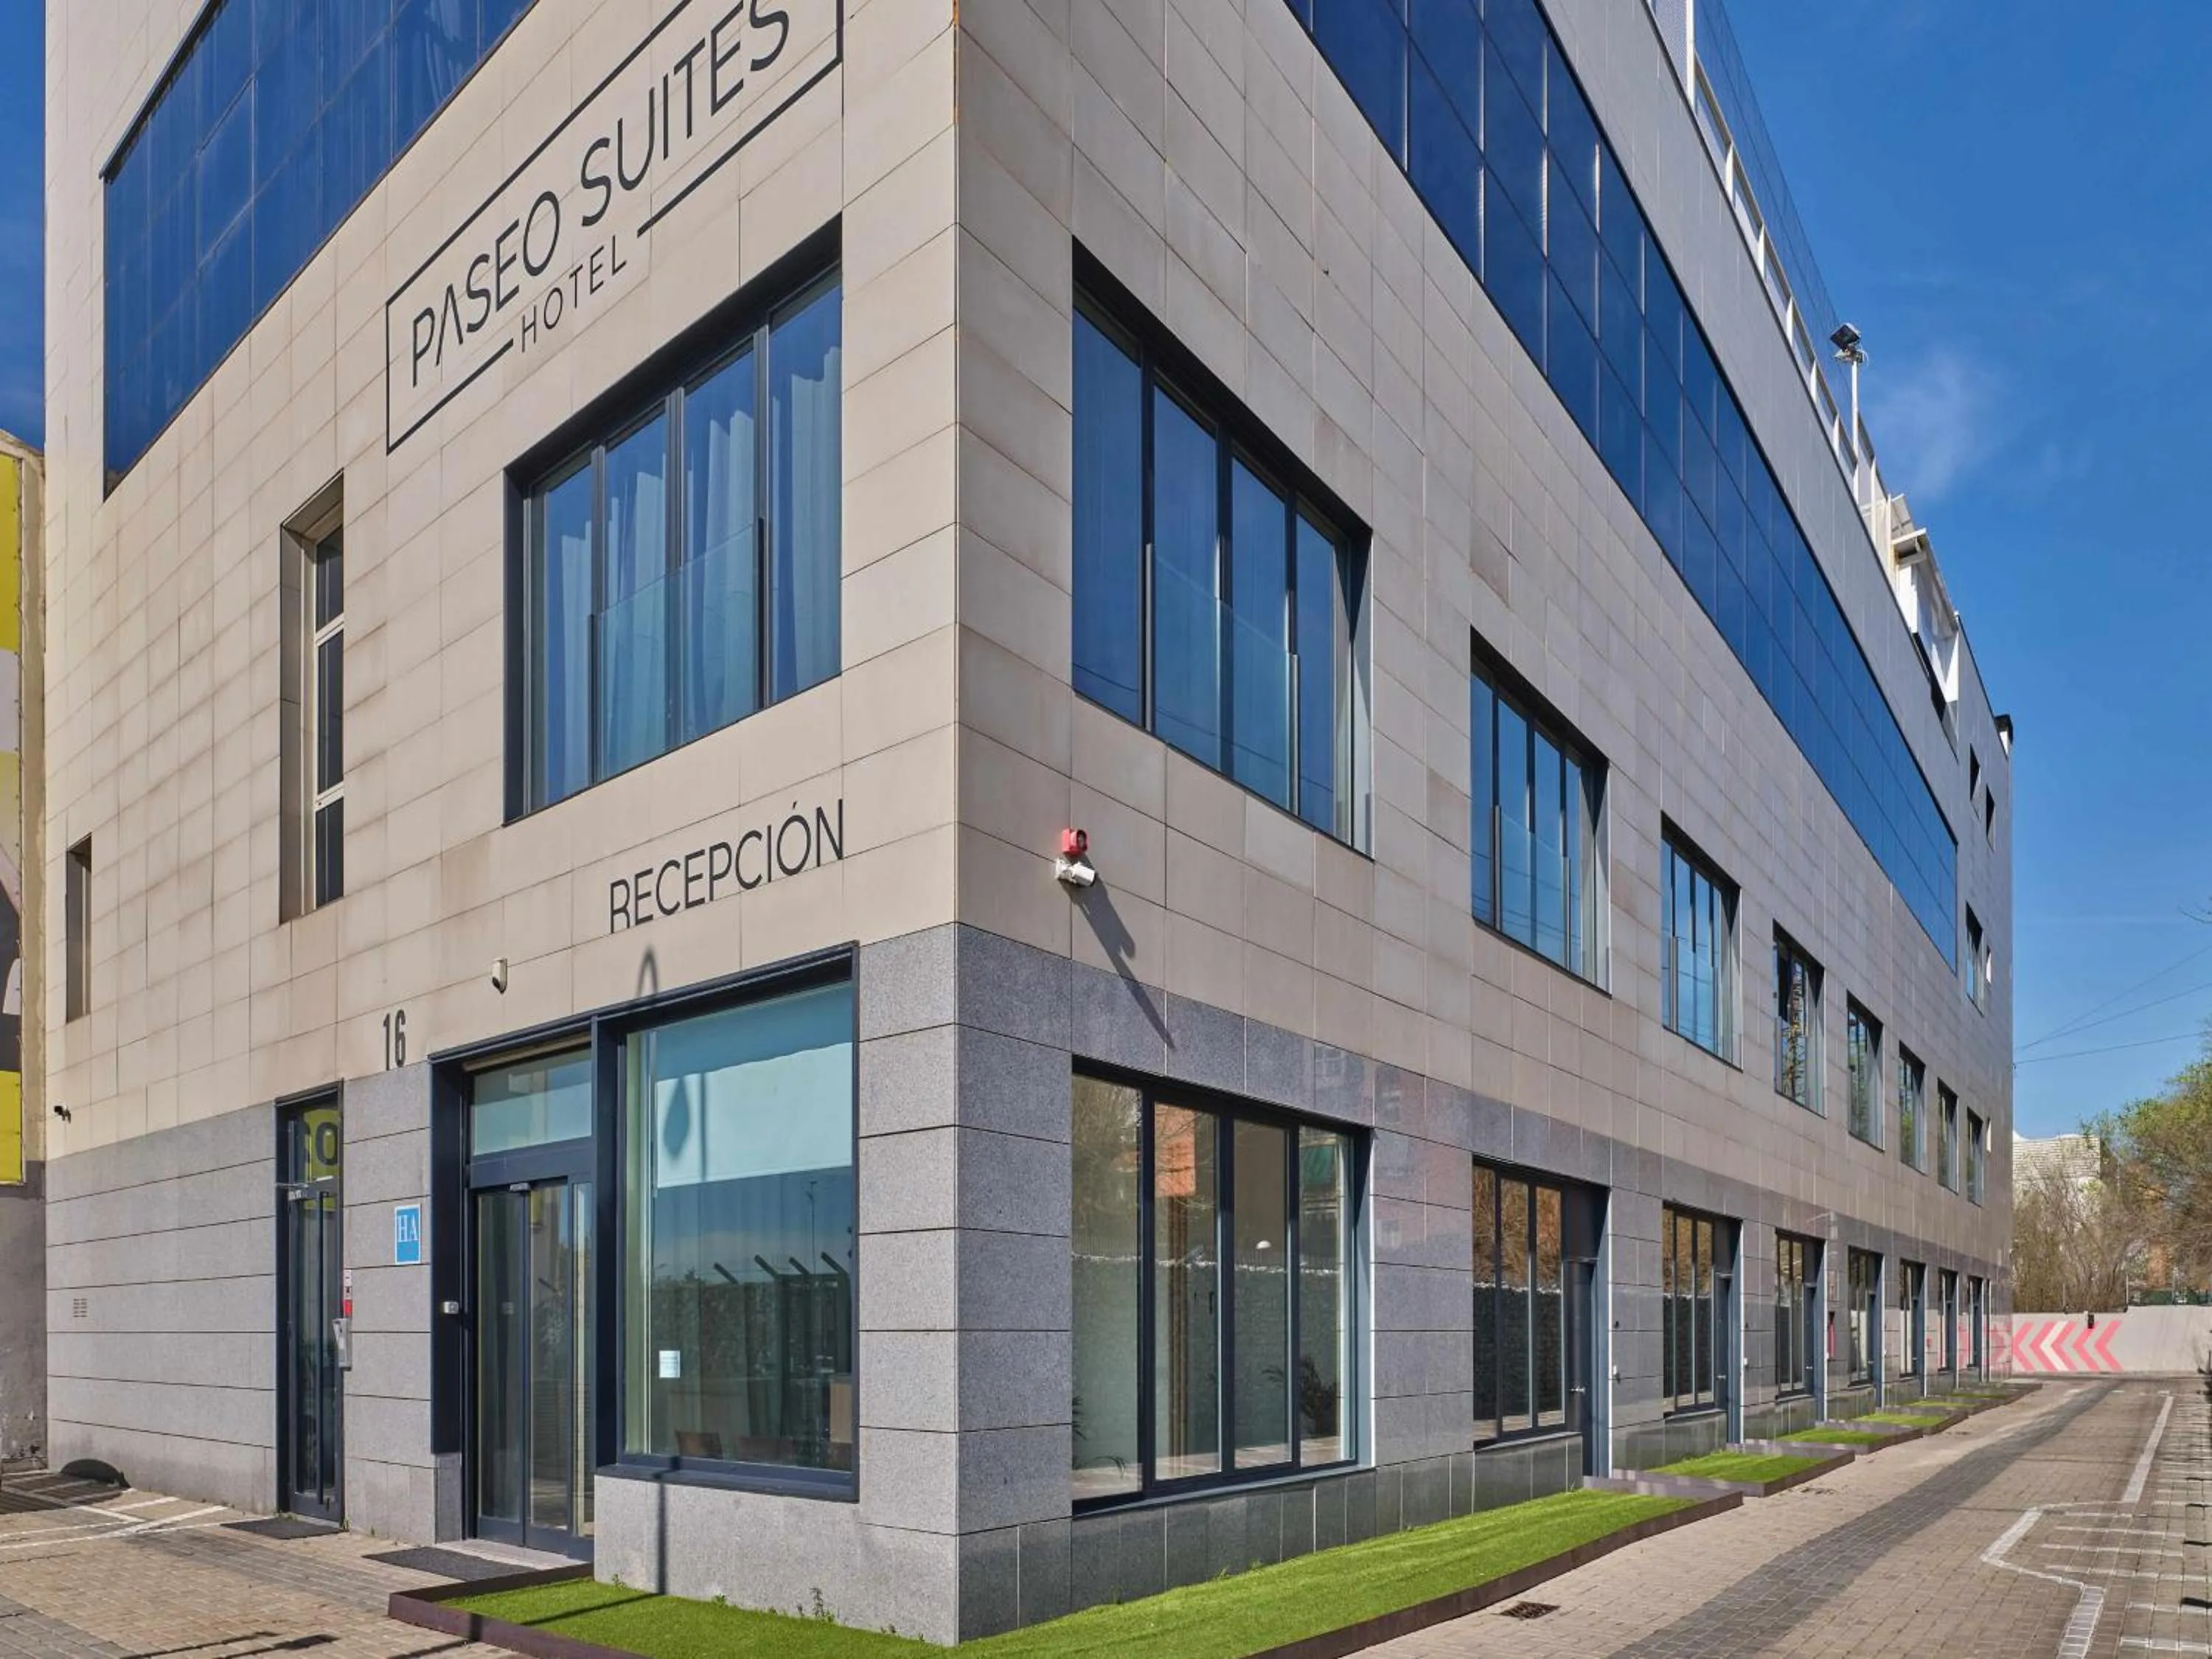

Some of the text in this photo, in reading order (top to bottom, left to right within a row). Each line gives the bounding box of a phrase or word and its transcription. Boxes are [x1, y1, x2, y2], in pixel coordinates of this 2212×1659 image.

[412, 0, 790, 389] PASEO SUITES
[521, 235, 627, 352] HOTEL
[610, 799, 843, 933] RECEPCIÓN
[383, 1009, 406, 1071] 16
[398, 1214, 418, 1242] HA
